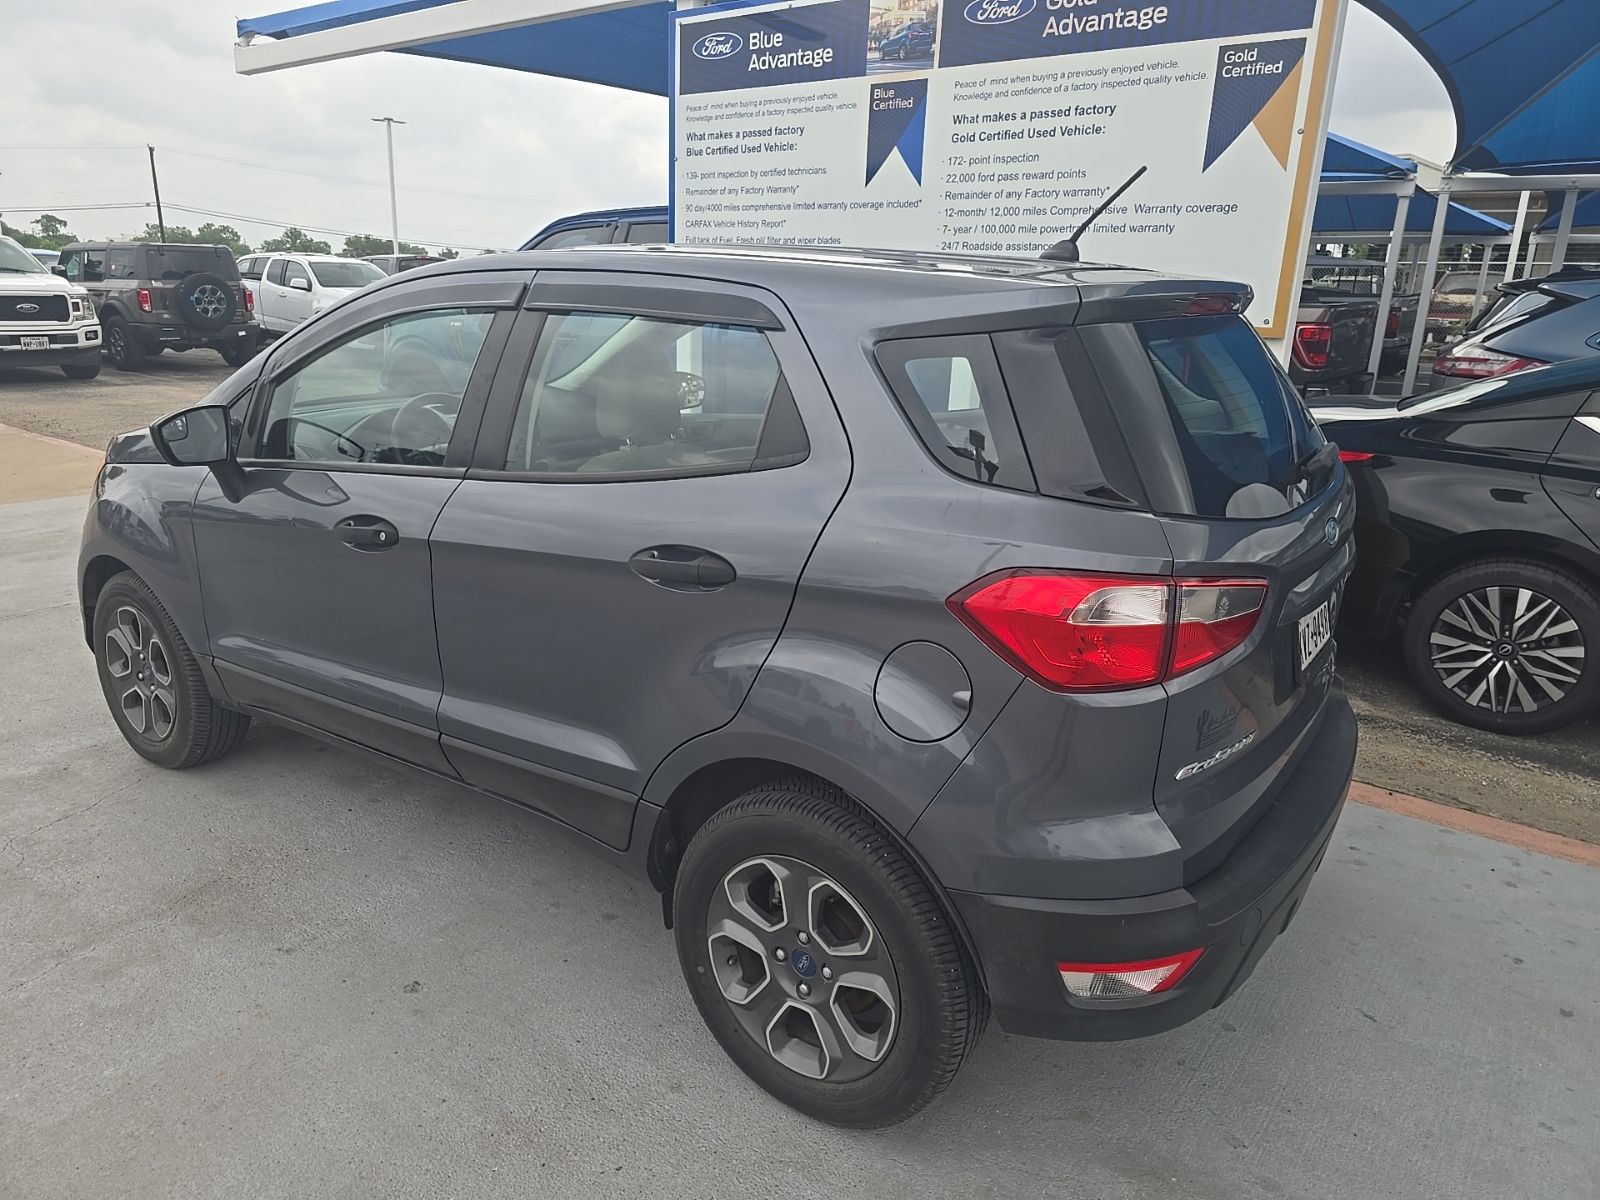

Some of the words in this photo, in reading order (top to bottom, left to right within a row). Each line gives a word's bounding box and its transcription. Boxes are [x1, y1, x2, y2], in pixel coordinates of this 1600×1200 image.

[1042, 5, 1168, 37] Advantage
[749, 31, 783, 50] Blue
[748, 46, 833, 72] Advantage
[1224, 48, 1258, 64] Gold
[954, 81, 977, 89] Peace
[979, 78, 987, 87] of
[990, 77, 1008, 86] mind
[1010, 75, 1030, 84] when
[1032, 72, 1058, 83] buying
[1068, 66, 1109, 80] previously
[1111, 64, 1145, 75] enjoyed
[1147, 60, 1180, 71] vehicle.
[1222, 61, 1283, 79] Certified
[874, 89, 895, 99] Blue
[954, 91, 993, 102] Knowledge
[995, 90, 1009, 99] and
[1011, 86, 1052, 97] confidence
[1054, 84, 1063, 93] of
[1071, 81, 1099, 92] factory
[1101, 75, 1141, 89] inspected
[1143, 72, 1172, 86] quality
[1175, 71, 1209, 83] vehicle.
[711, 102, 723, 110] mind
[724, 101, 739, 109] when
[740, 100, 758, 108] buying
[763, 96, 792, 106] previously
[793, 94, 816, 103] enjoyed
[816, 92, 839, 100] vehicle.
[873, 97, 914, 110] Certified
[686, 115, 713, 123] Knowledge
[714, 112, 724, 120] and
[725, 111, 754, 120] confidence
[787, 105, 814, 115] inspected
[815, 104, 834, 113] quality
[953, 114, 979, 125] What
[982, 112, 1017, 123] makes
[1020, 112, 1027, 120] a
[1029, 106, 1071, 122] passed
[1074, 104, 1117, 117] factory
[686, 132, 706, 142] What
[708, 131, 733, 140] makes
[742, 127, 772, 140] passed
[774, 125, 805, 137] factory
[951, 132, 976, 144] Gold
[979, 129, 1025, 142] Certified
[1028, 126, 1056, 139] Used
[1060, 124, 1106, 137] Vehicle:
[686, 147, 703, 157] Blue
[706, 146, 739, 156] Certified
[741, 143, 762, 154] Used
[764, 141, 798, 152] Vehicle:
[948, 156, 967, 166] 172-
[969, 155, 991, 167] point
[993, 153, 1040, 165] inspection
[700, 171, 716, 181] point
[717, 170, 749, 180] inspection
[750, 170, 758, 180] by
[760, 168, 786, 177] certified
[788, 167, 827, 176] technicians
[946, 173, 975, 184] 22,000
[978, 172, 995, 182] ford
[997, 173, 1019, 183] pass
[1022, 170, 1055, 180] reward
[1057, 169, 1087, 181] points
[685, 188, 719, 196] Remainder
[720, 187, 726, 195] of
[727, 188, 739, 197] any
[741, 186, 765, 196] Factory
[945, 190, 992, 200] Remainder
[994, 189, 1004, 199] of
[1006, 191, 1023, 201] any
[1025, 188, 1060, 200] Factory
[685, 204, 693, 212] 90
[724, 203, 740, 212] miles
[741, 203, 791, 213] comprehensive
[793, 202, 816, 210] limited
[817, 202, 848, 211] warranty
[850, 202, 884, 211] coverage
[944, 207, 987, 218] 12-month/
[990, 207, 1020, 218] 12,000
[1022, 206, 1047, 216] miles
[1134, 204, 1183, 216] Warranty
[1186, 204, 1238, 215] coverage
[685, 220, 712, 228] CARFAX
[713, 220, 736, 228] Vehicle
[737, 220, 760, 229] History
[953, 226, 972, 236] year
[980, 224, 1016, 235] 100,000
[1018, 224, 1038, 234] mile
[1040, 223, 1090, 235] powertrn
[1093, 223, 1126, 233] limited
[1129, 223, 1175, 235] warranty
[783, 236, 796, 245] and
[798, 236, 816, 245] wiper
[818, 236, 841, 245] blades
[941, 242, 960, 251] 24/7
[962, 241, 1003, 251] Roadside
